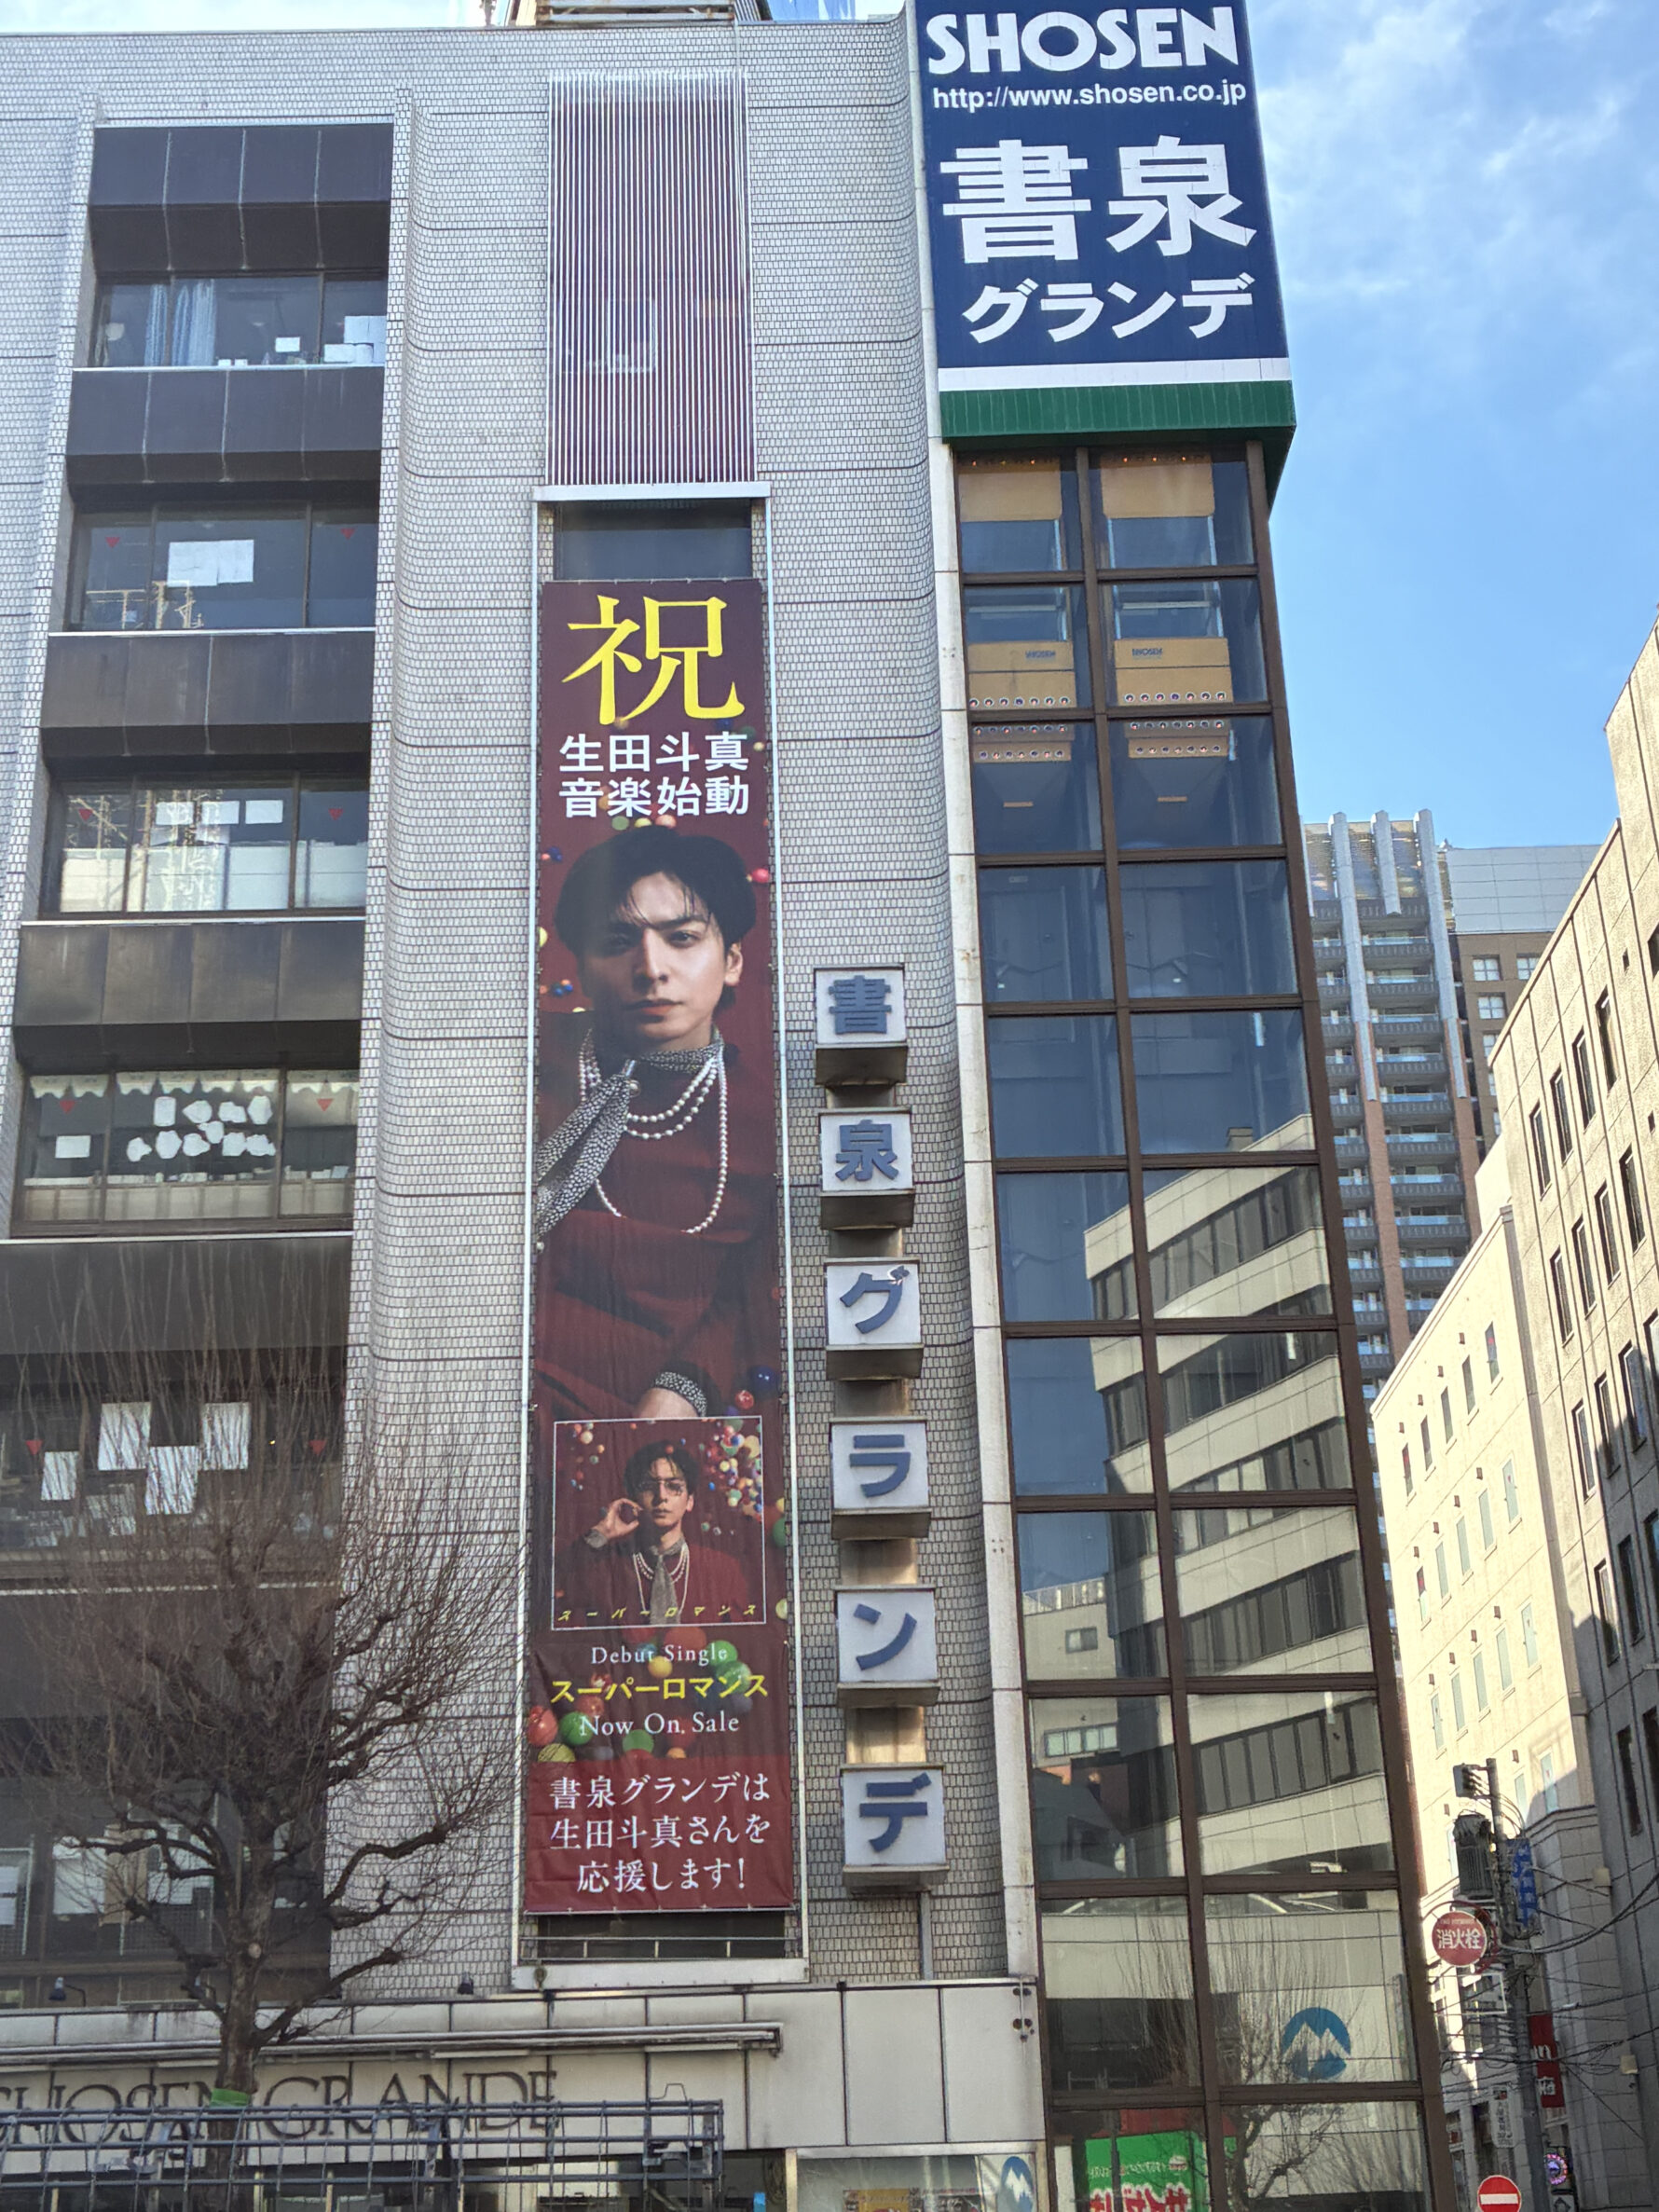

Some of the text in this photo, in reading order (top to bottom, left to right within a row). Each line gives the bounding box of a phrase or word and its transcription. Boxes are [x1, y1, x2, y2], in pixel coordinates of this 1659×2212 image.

[926, 7, 1239, 75] SHOSEN
[933, 79, 1246, 112] http://www.shosen.co.jp
[939, 135, 1256, 263] 書泉
[963, 272, 1255, 343] グランデ
[561, 595, 745, 725] 祝
[559, 732, 749, 773] 生田斗真
[559, 776, 749, 817] 音楽始動
[591, 1642, 728, 1667] Debut Single
[551, 1675, 769, 1703] スーパーロマンス
[580, 1711, 739, 1736] Now On Sale
[550, 1772, 770, 1809] 書泉グランデは
[550, 1814, 770, 1849] 生田斗真さんを
[1436, 1928, 1482, 1949] 消火栓
